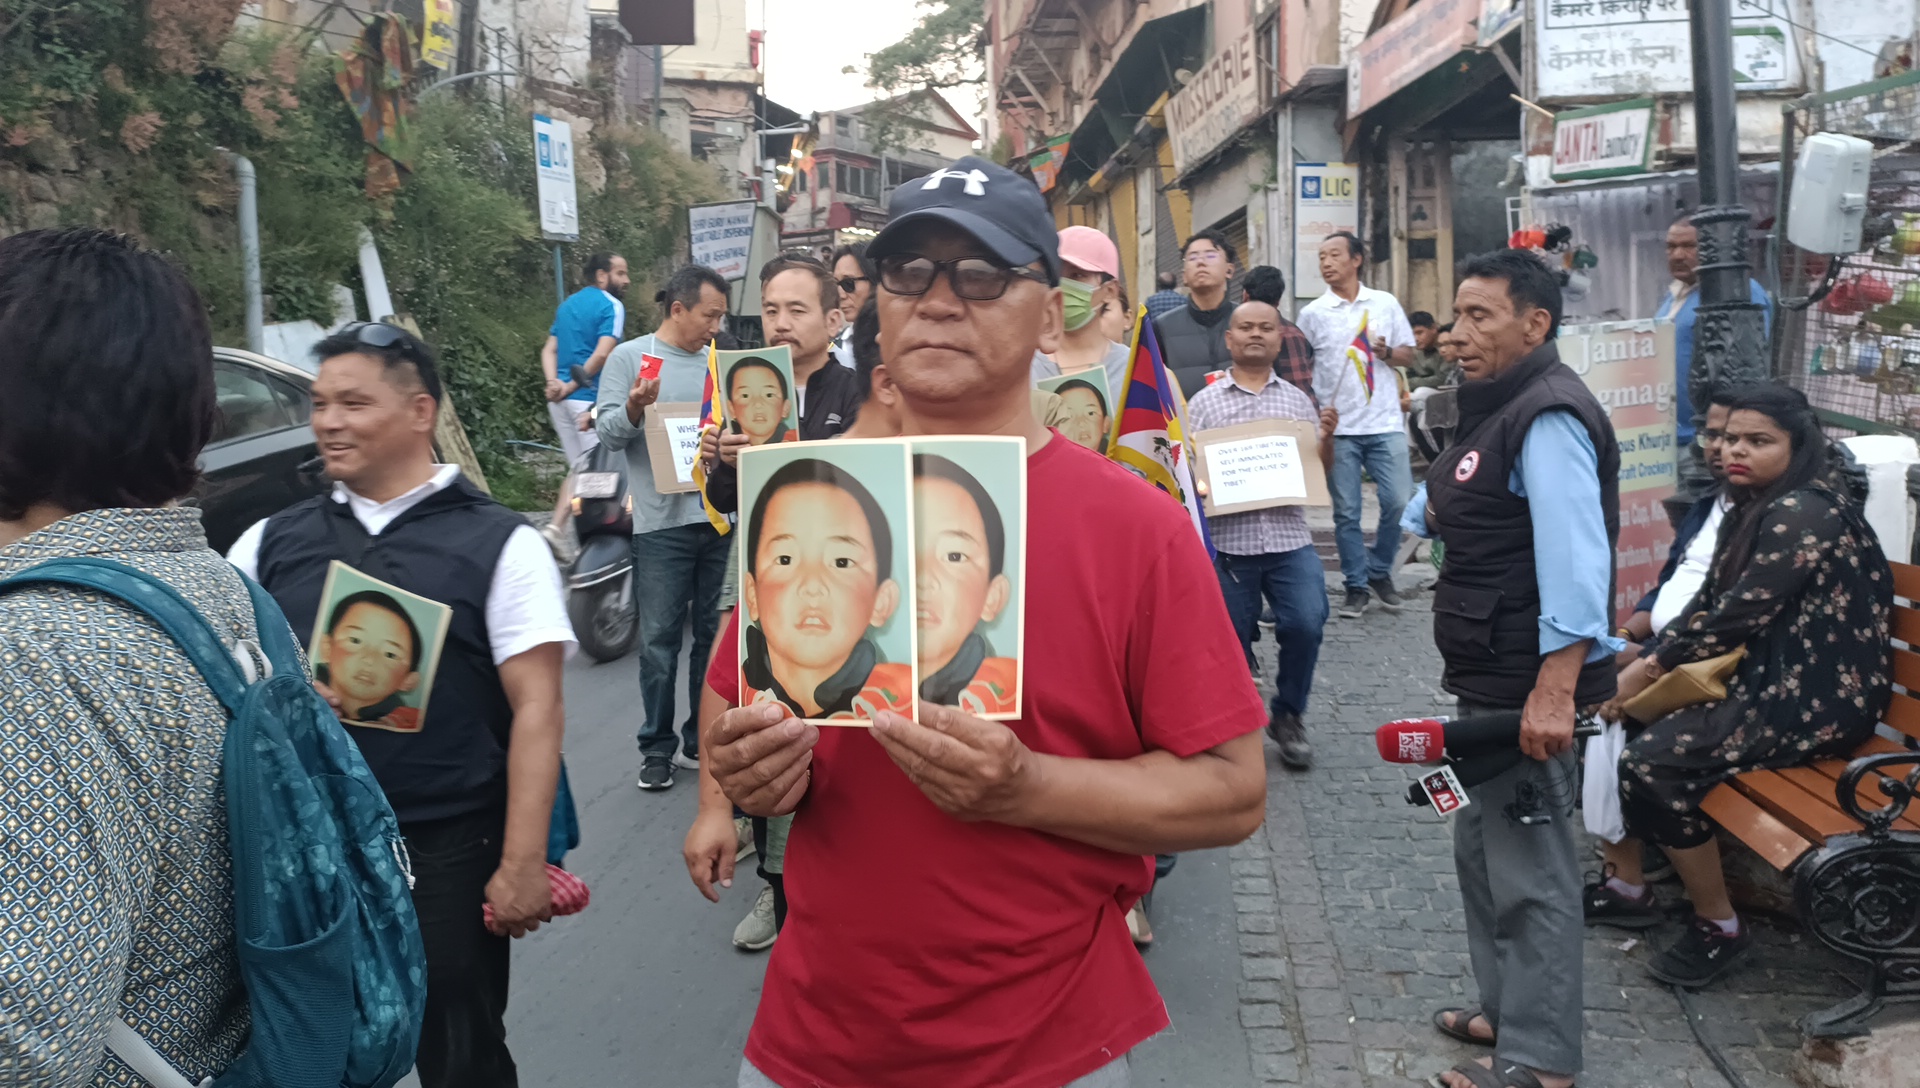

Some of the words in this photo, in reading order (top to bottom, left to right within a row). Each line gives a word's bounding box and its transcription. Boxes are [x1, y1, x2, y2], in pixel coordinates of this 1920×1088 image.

[1556, 121, 1599, 165] JANTA
[1325, 178, 1352, 196] LIC
[1573, 334, 1657, 375] Janta
[1597, 382, 1671, 418] gmag
[677, 424, 699, 434] WHE
[1619, 437, 1635, 453] ous
[684, 456, 695, 466] LA
[1436, 792, 1455, 810] TV
